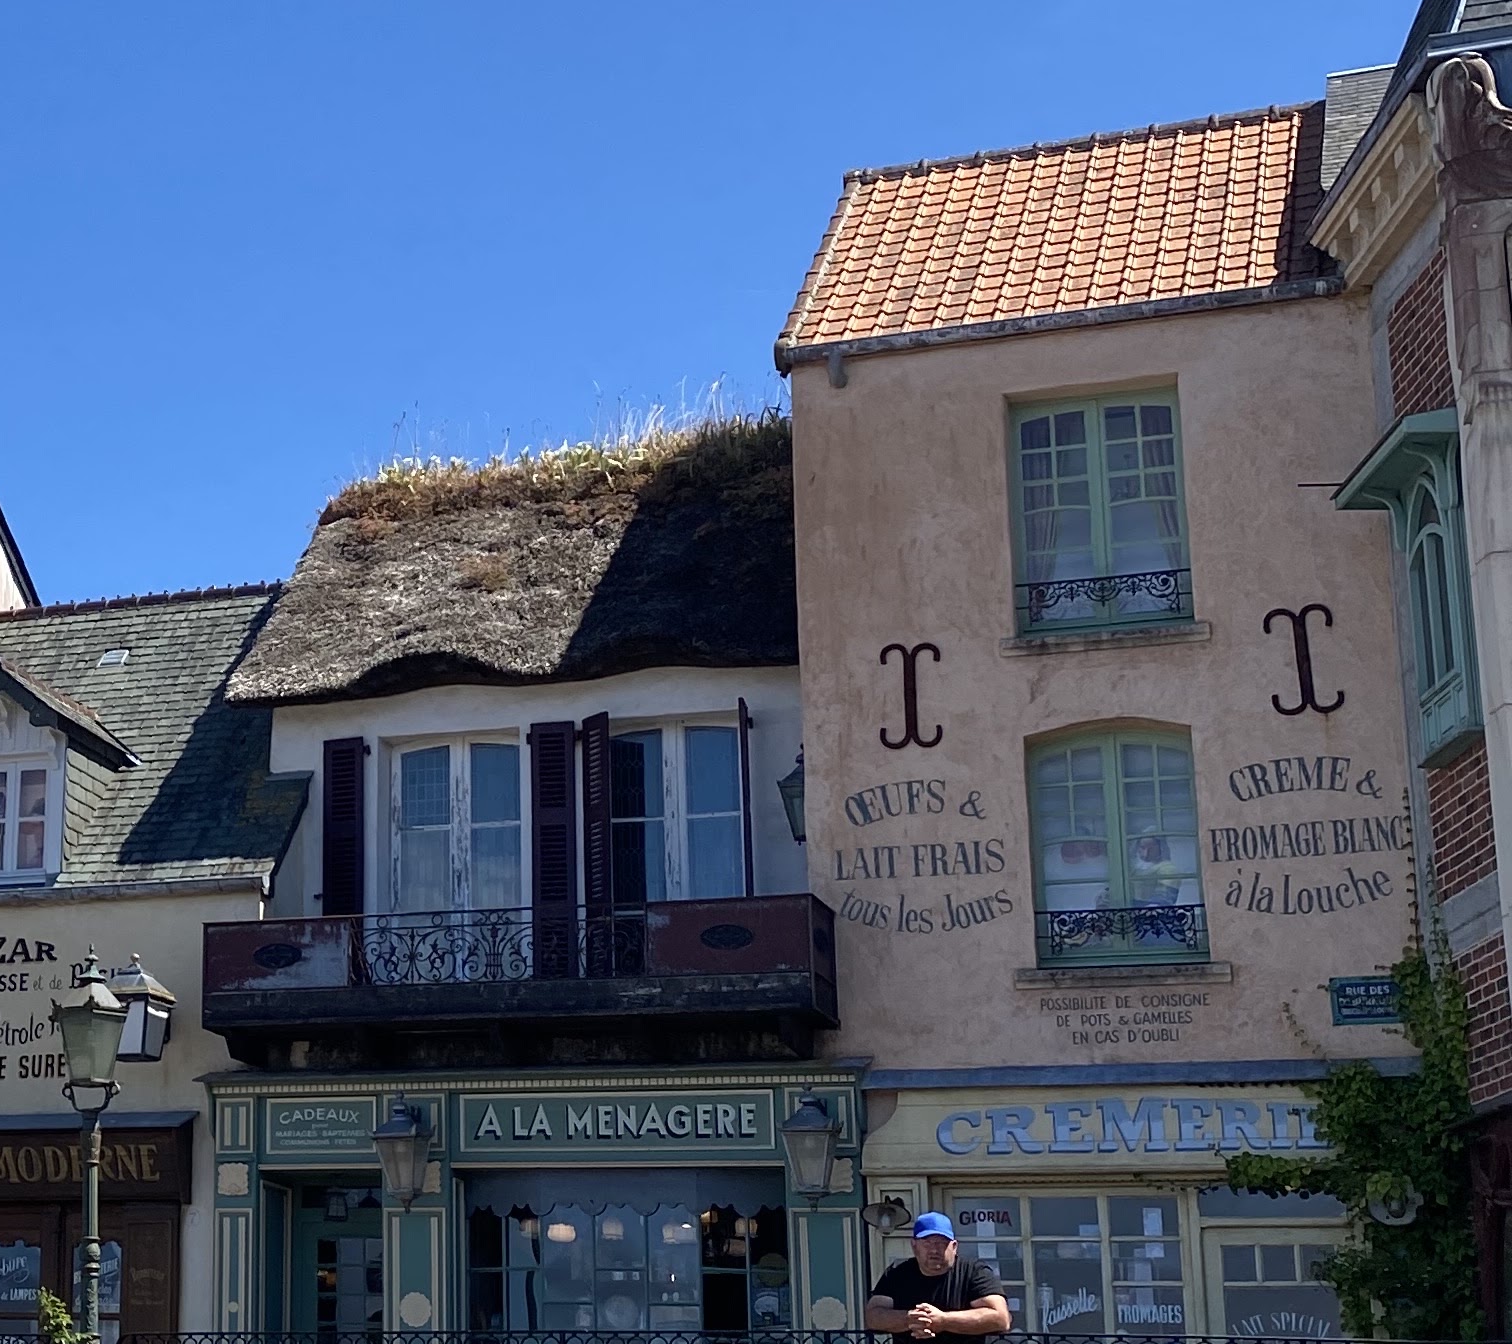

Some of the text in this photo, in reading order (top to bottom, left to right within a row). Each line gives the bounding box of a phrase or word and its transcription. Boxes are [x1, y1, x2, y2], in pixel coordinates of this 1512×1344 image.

[1228, 755, 1383, 802] CREME &
[959, 790, 987, 820] &
[1208, 814, 1405, 863] FROMAGE BLANC
[835, 838, 1006, 881] LAIT FRAIS
[1246, 871, 1275, 915] la
[1279, 867, 1394, 915] Louche
[839, 887, 1014, 934] tous les Jours
[33, 974, 44, 991] et
[49, 975, 63, 990] de
[1345, 985, 1390, 995] RUE DES
[1040, 992, 1211, 1011] POSSIBILITE DE CONSIGNE
[1056, 1010, 1193, 1028] DE POTS & GAMELLES
[1072, 1028, 1180, 1045] EN CAS D'OUBLI
[18, 1053, 66, 1079] SURE
[279, 1107, 360, 1124] CADEAUX
[475, 1102, 758, 1140] A LA MENAGERE
[959, 1210, 1012, 1227] GLORIA
[1, 1291, 9, 1301] de
[10, 1288, 37, 1301] LAMPES
[1117, 1304, 1184, 1324] FROMAGES
